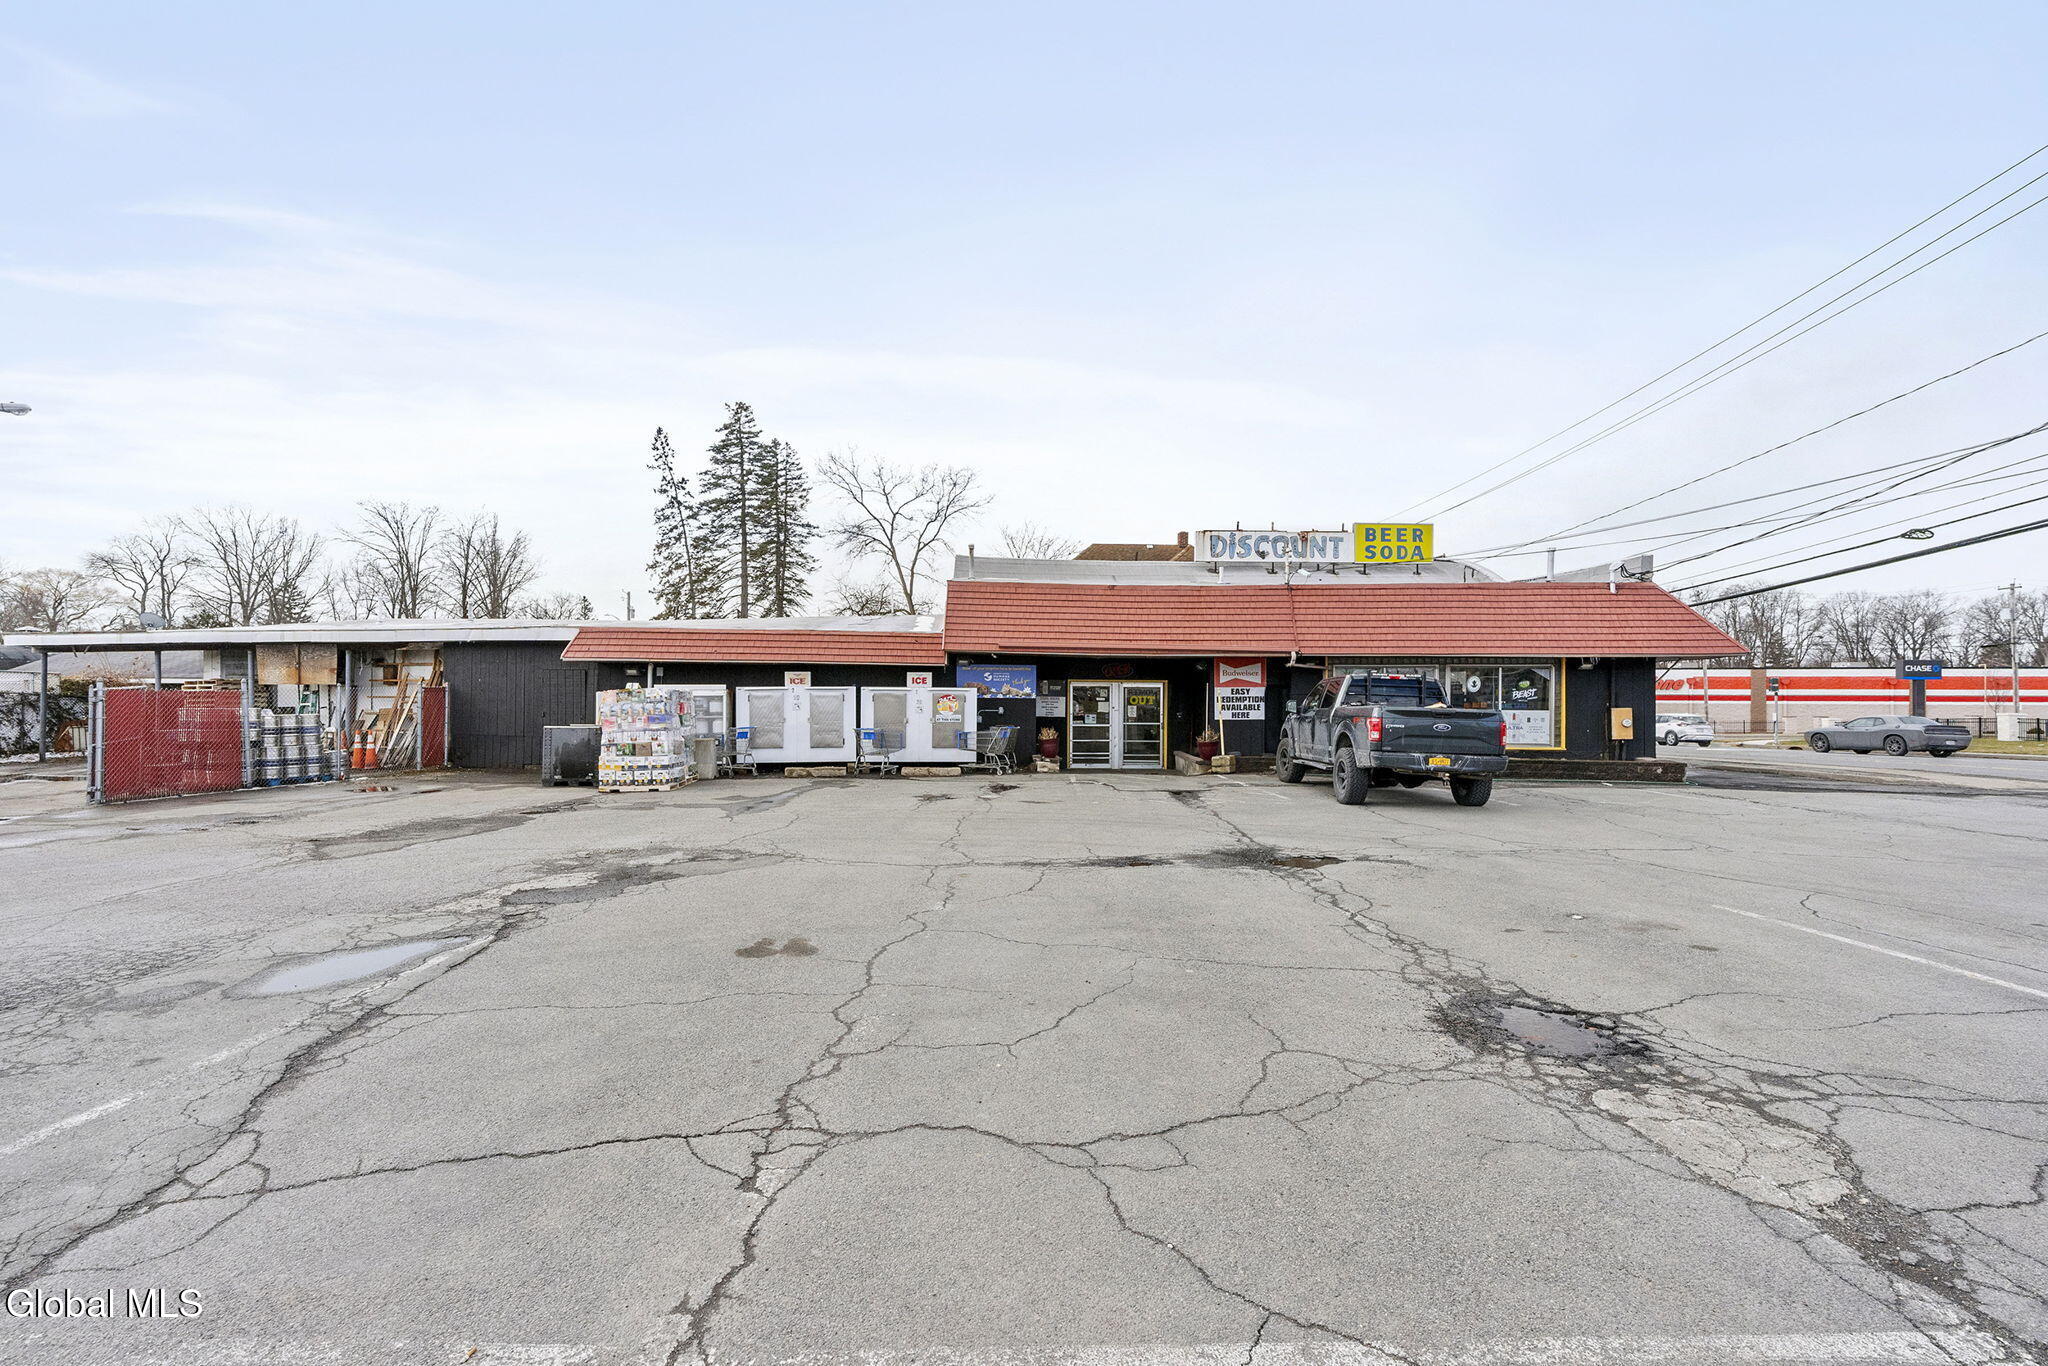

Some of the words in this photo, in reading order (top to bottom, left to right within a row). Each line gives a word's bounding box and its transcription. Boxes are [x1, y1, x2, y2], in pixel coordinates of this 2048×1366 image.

[1365, 527, 1424, 543] BEER
[1365, 545, 1424, 560] SODA
[789, 677, 806, 685] ICE
[911, 677, 928, 685] ICE
[1512, 689, 1537, 700] BEAST
[1129, 695, 1155, 705] OUT
